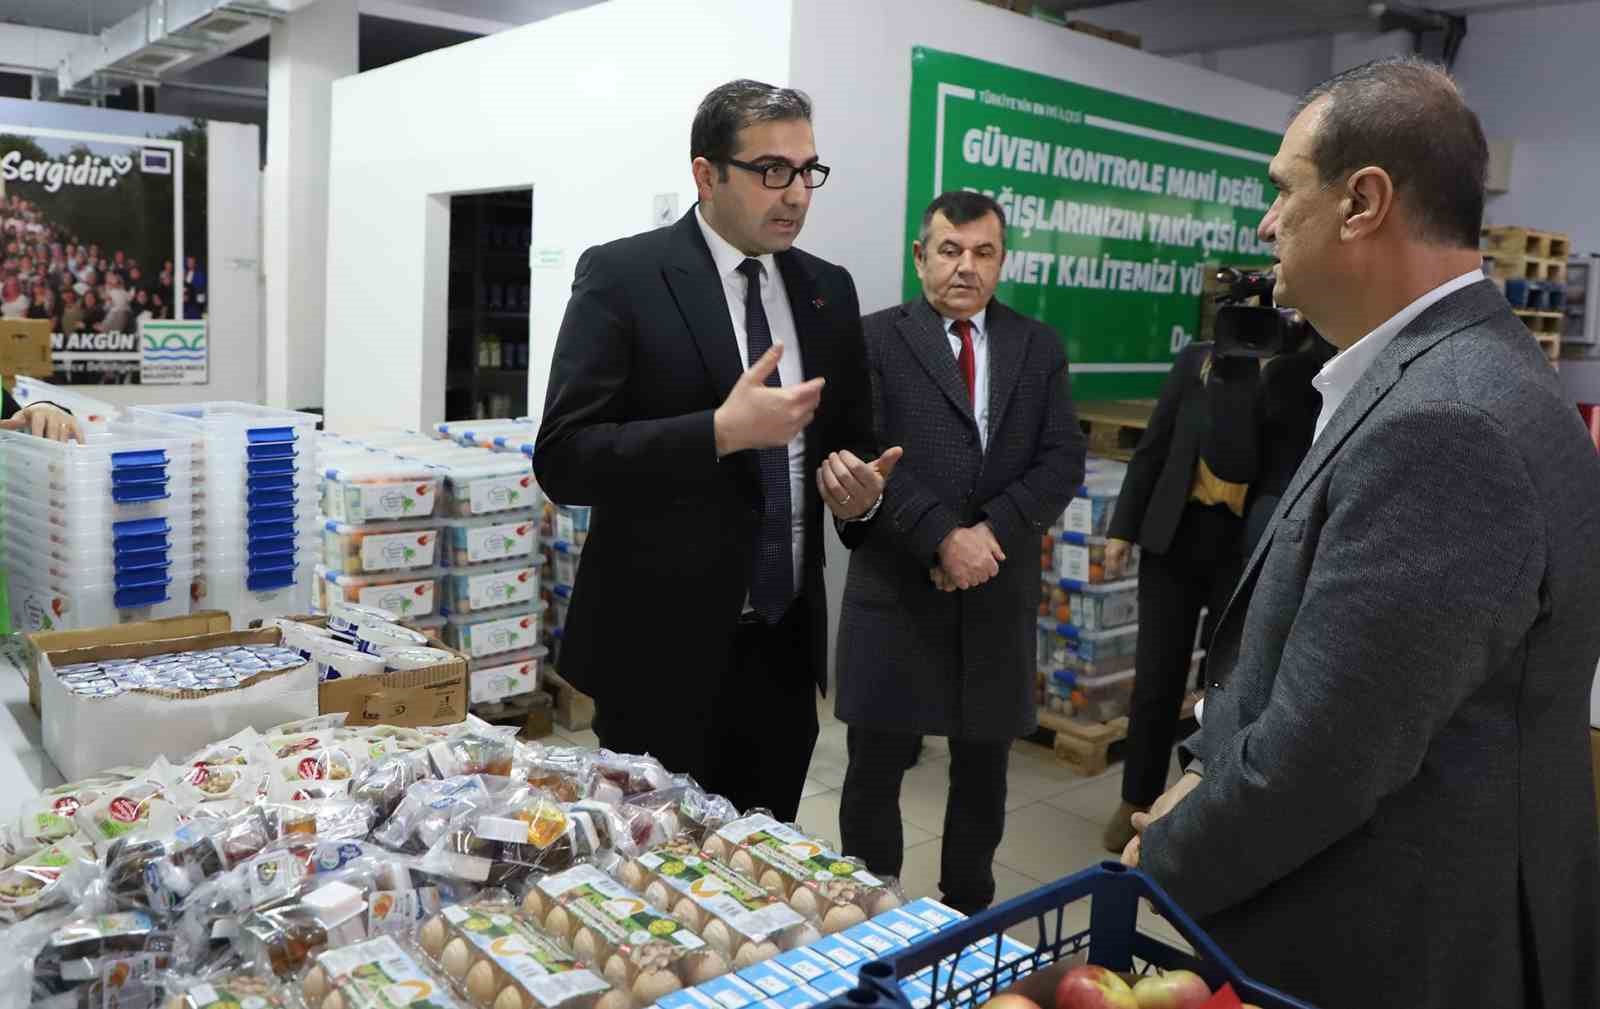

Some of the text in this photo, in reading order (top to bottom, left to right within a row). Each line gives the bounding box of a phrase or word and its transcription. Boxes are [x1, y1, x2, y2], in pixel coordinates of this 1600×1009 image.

[0, 151, 117, 191] Sevgidir.
[963, 125, 1050, 174] GÜVEN
[1053, 145, 1164, 193] KONTROLE
[1166, 166, 1217, 201] MANİ
[962, 186, 1144, 241] ĞIŞLARINIZIN
[1148, 212, 1236, 257] TAKİPÇİSİ
[1056, 253, 1177, 294] KALİTEMİZİ
[1180, 262, 1206, 296] YÜ
[66, 330, 134, 350] AKGÜN
